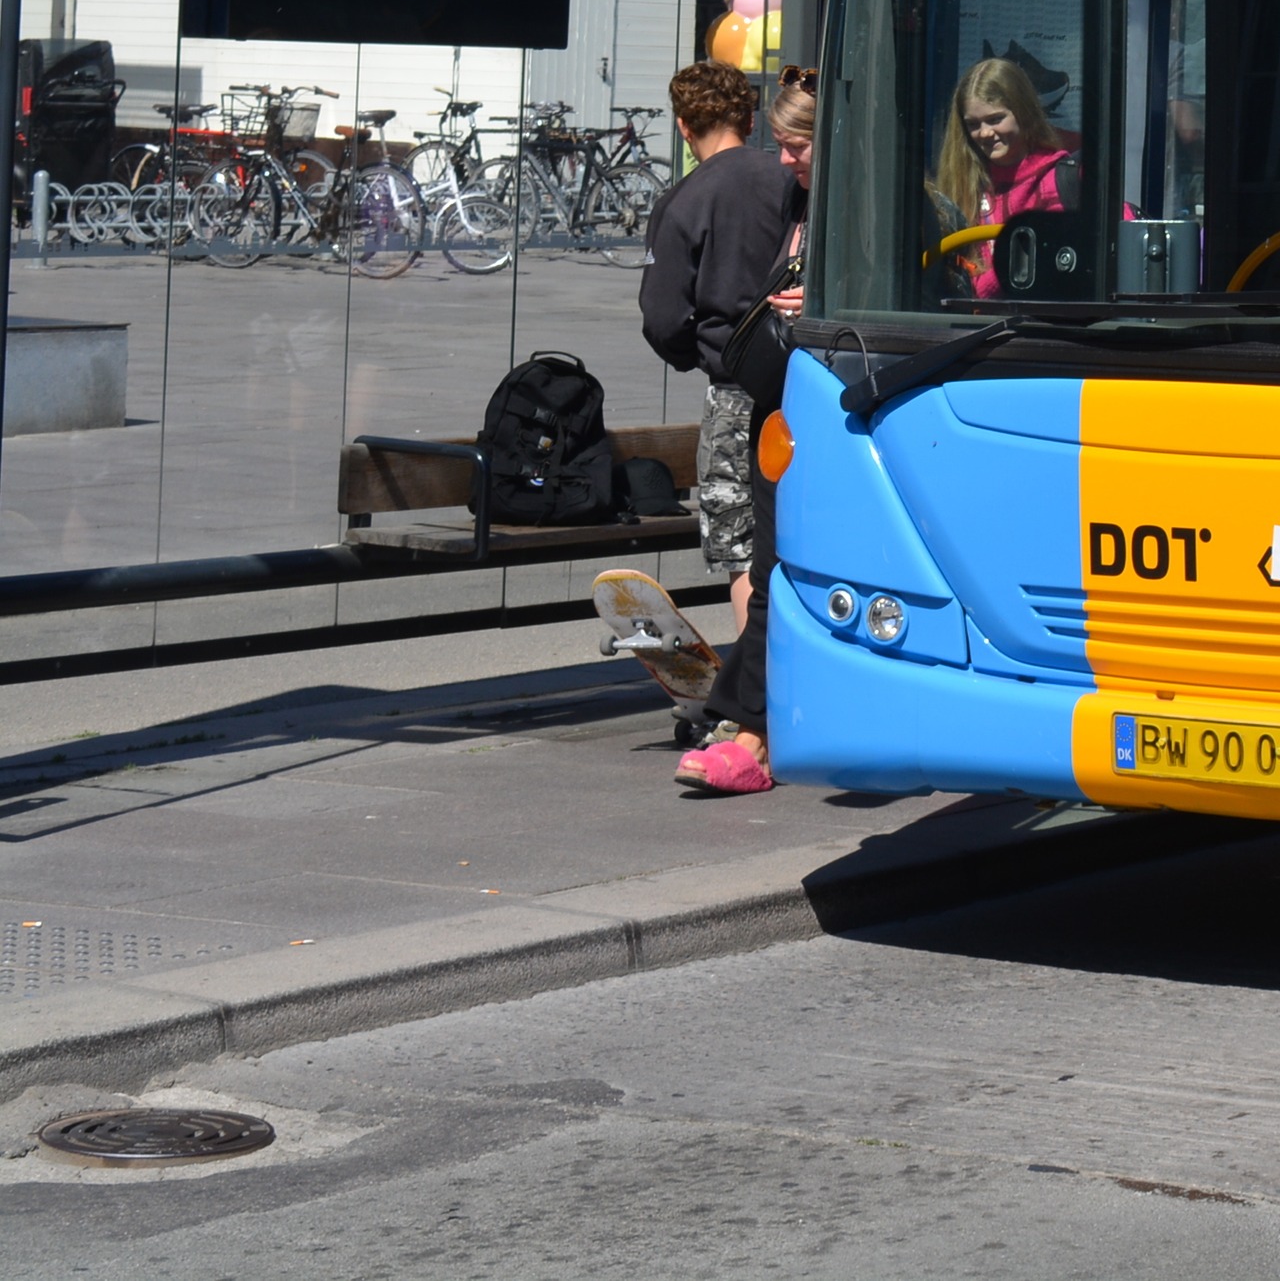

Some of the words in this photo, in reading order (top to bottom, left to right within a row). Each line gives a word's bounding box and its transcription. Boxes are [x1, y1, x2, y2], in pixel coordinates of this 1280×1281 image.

[1090, 522, 1212, 583] DOT
[1117, 747, 1133, 762] DK
[1141, 724, 1188, 769] BW
[1201, 729, 1244, 773] 90
